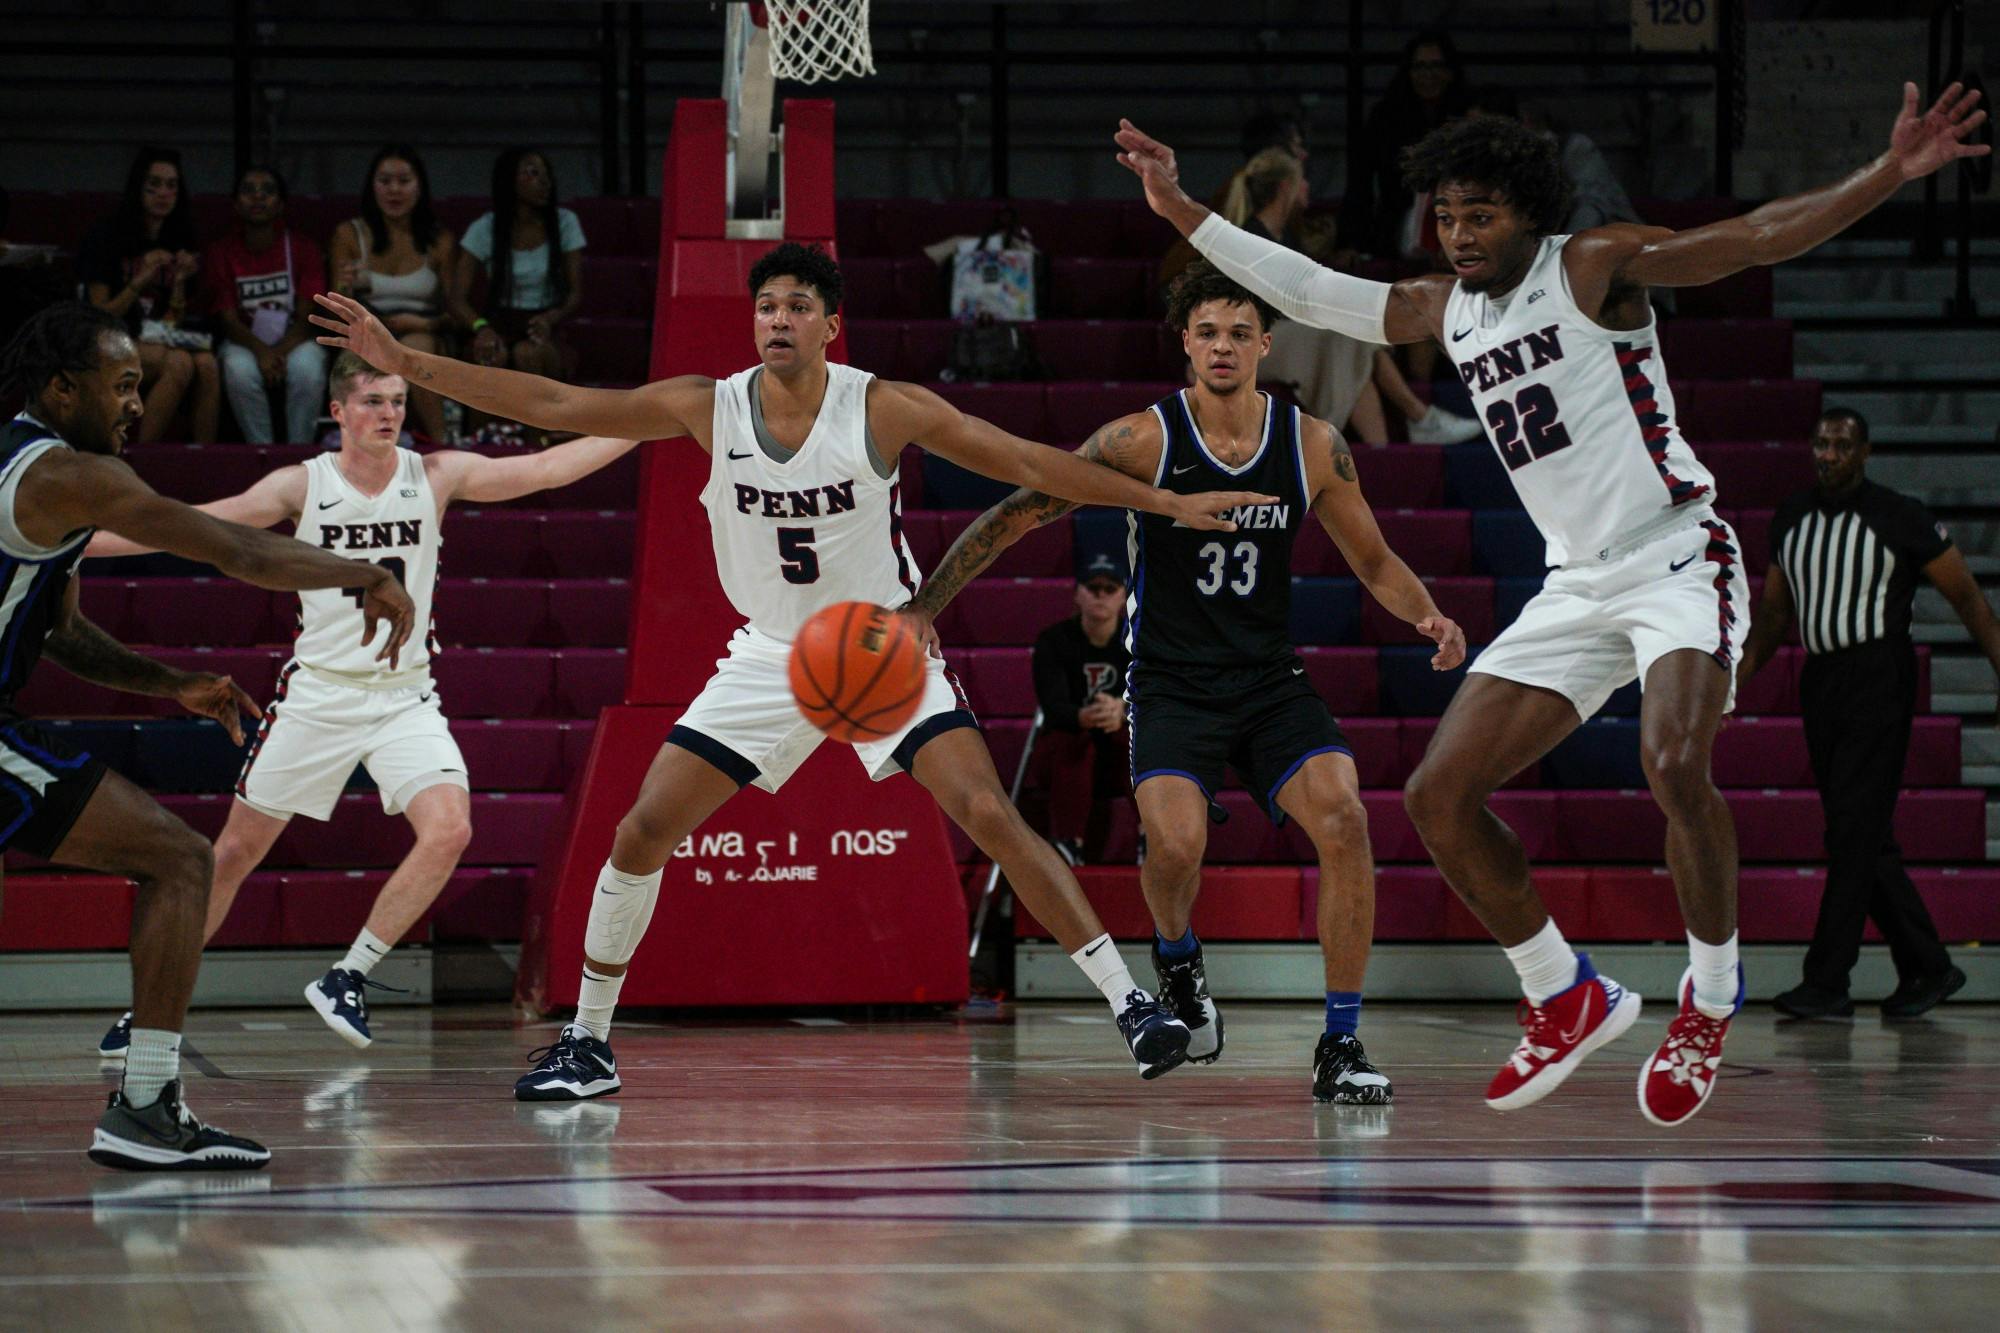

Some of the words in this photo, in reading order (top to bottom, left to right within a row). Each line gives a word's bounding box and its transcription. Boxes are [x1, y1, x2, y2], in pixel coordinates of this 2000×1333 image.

[1647, 0, 1705, 25] 120
[1459, 324, 1564, 398] PENN
[1486, 383, 1573, 471] 22
[734, 479, 856, 518] PENN
[319, 519, 423, 550] PENN
[776, 526, 821, 585] 5
[1196, 541, 1259, 596] 33
